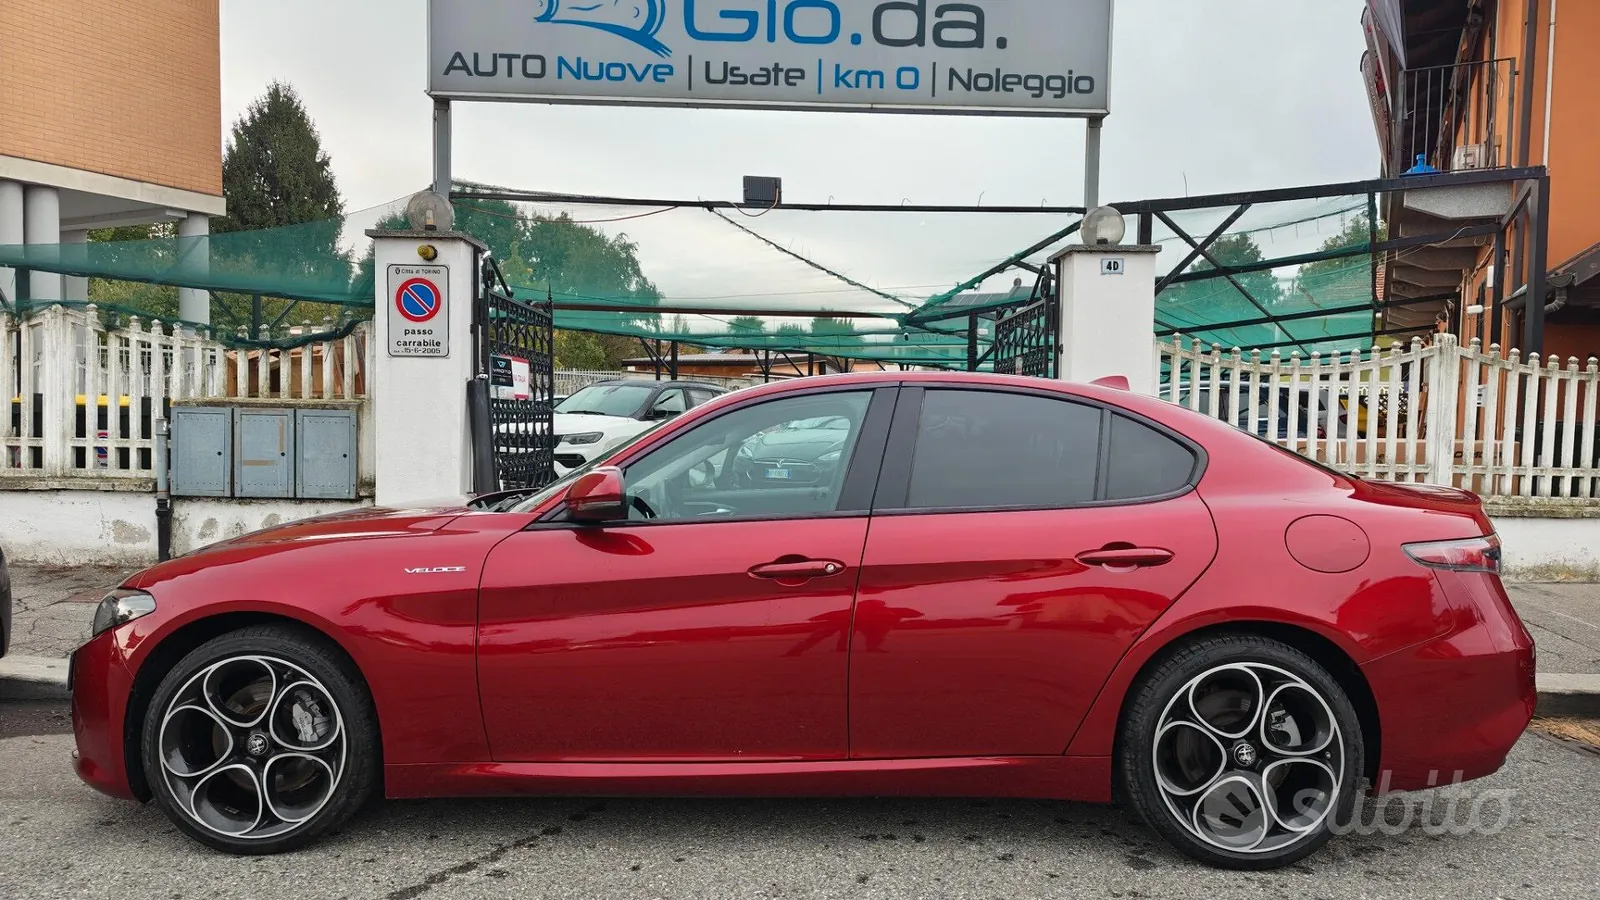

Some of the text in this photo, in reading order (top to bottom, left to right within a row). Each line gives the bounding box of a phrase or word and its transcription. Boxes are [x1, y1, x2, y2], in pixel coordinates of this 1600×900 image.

[684, 0, 1008, 50] Gio.da.
[443, 51, 1095, 99] AUTO Nuove Usate km 0 Noleggio
[1106, 260, 1119, 271] 4D
[404, 328, 433, 336] passo
[396, 339, 441, 347] carrabile
